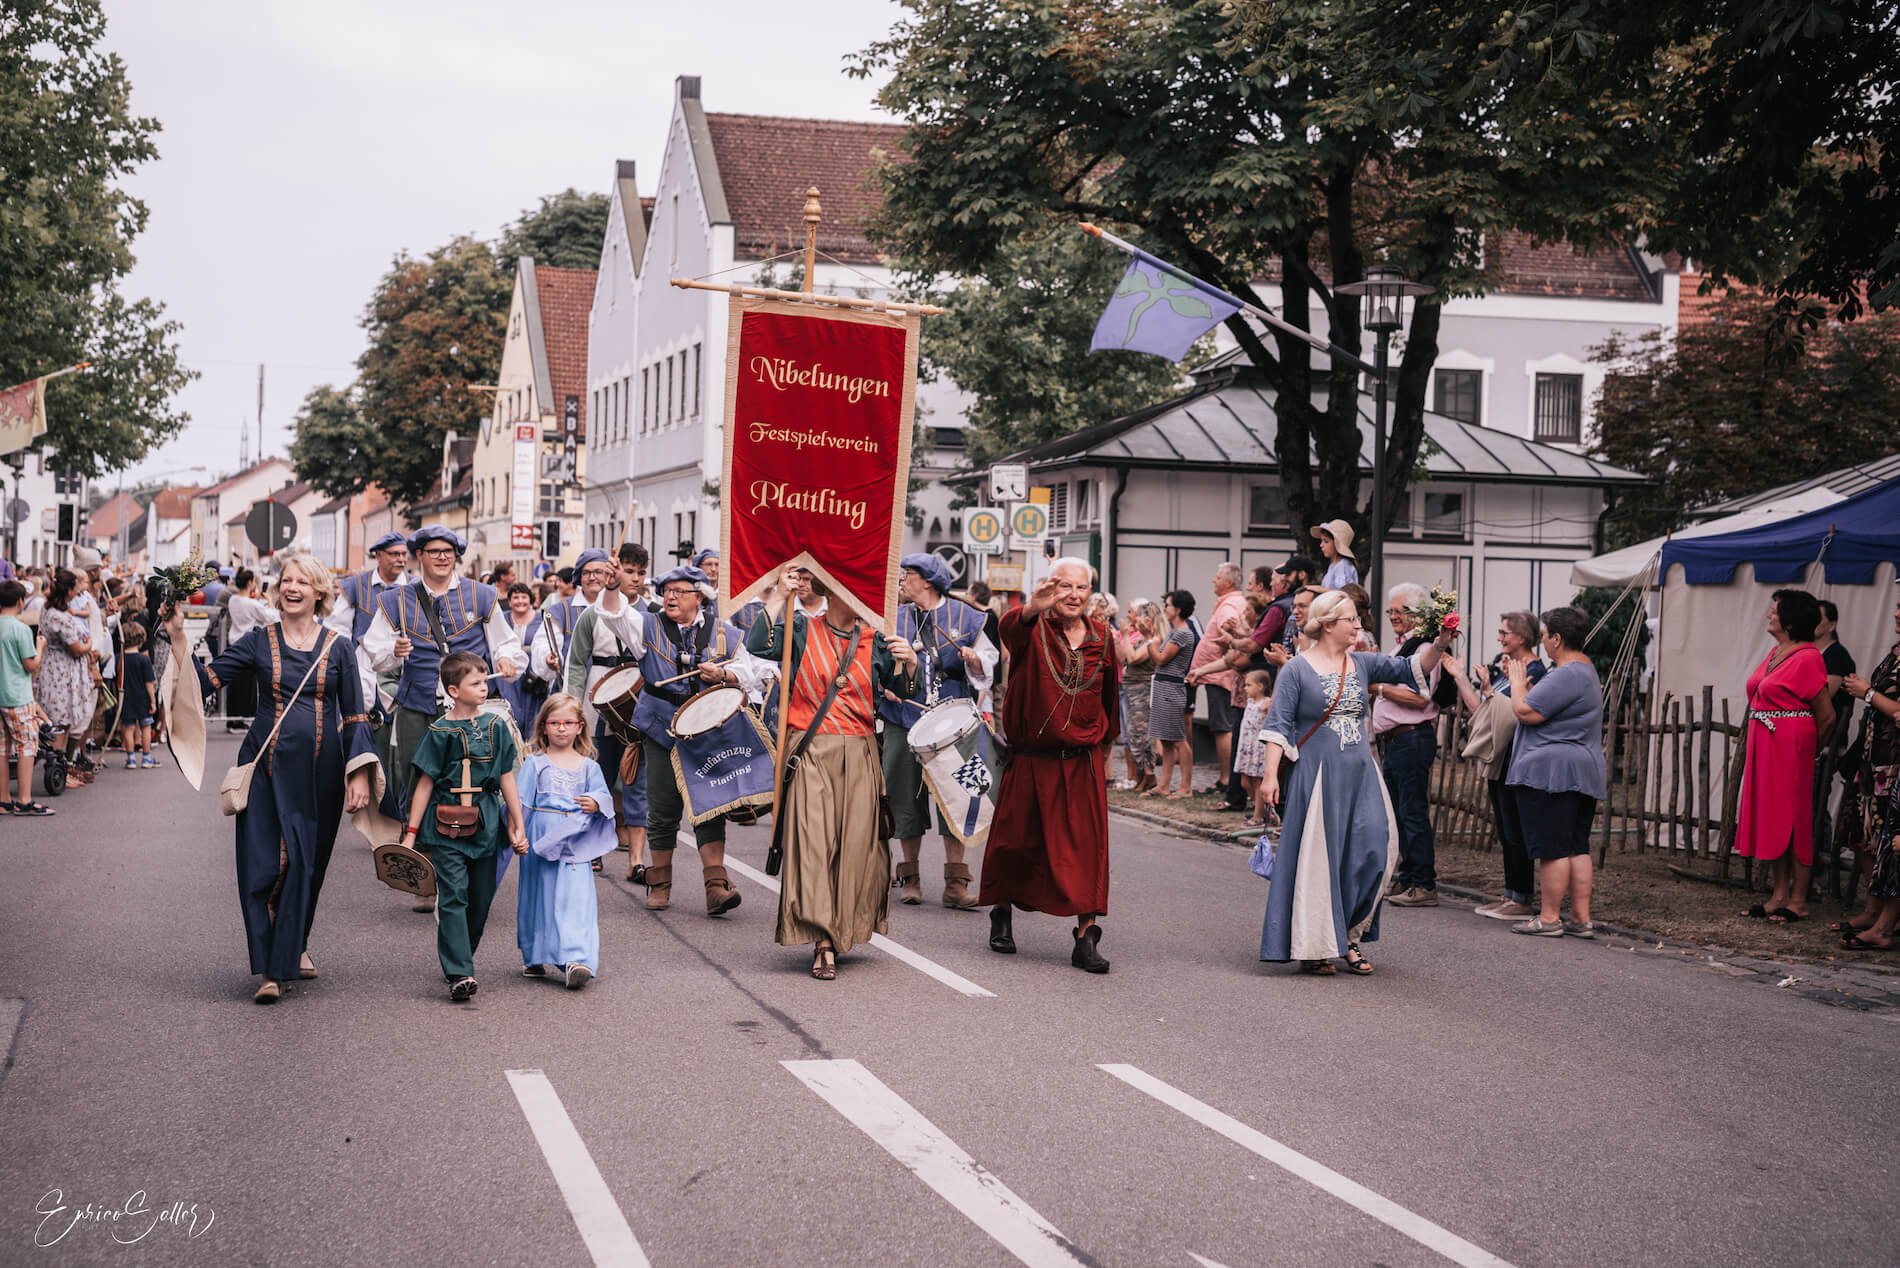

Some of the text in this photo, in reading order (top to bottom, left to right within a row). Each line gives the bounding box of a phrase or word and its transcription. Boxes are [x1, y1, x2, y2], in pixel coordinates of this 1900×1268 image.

[750, 356, 889, 403] Nibelungen
[749, 422, 878, 453] Festspielverein
[750, 480, 867, 529] Plattling
[976, 519, 992, 537] H
[695, 746, 752, 778] Fanfarenzug
[709, 764, 752, 788] Plattling
